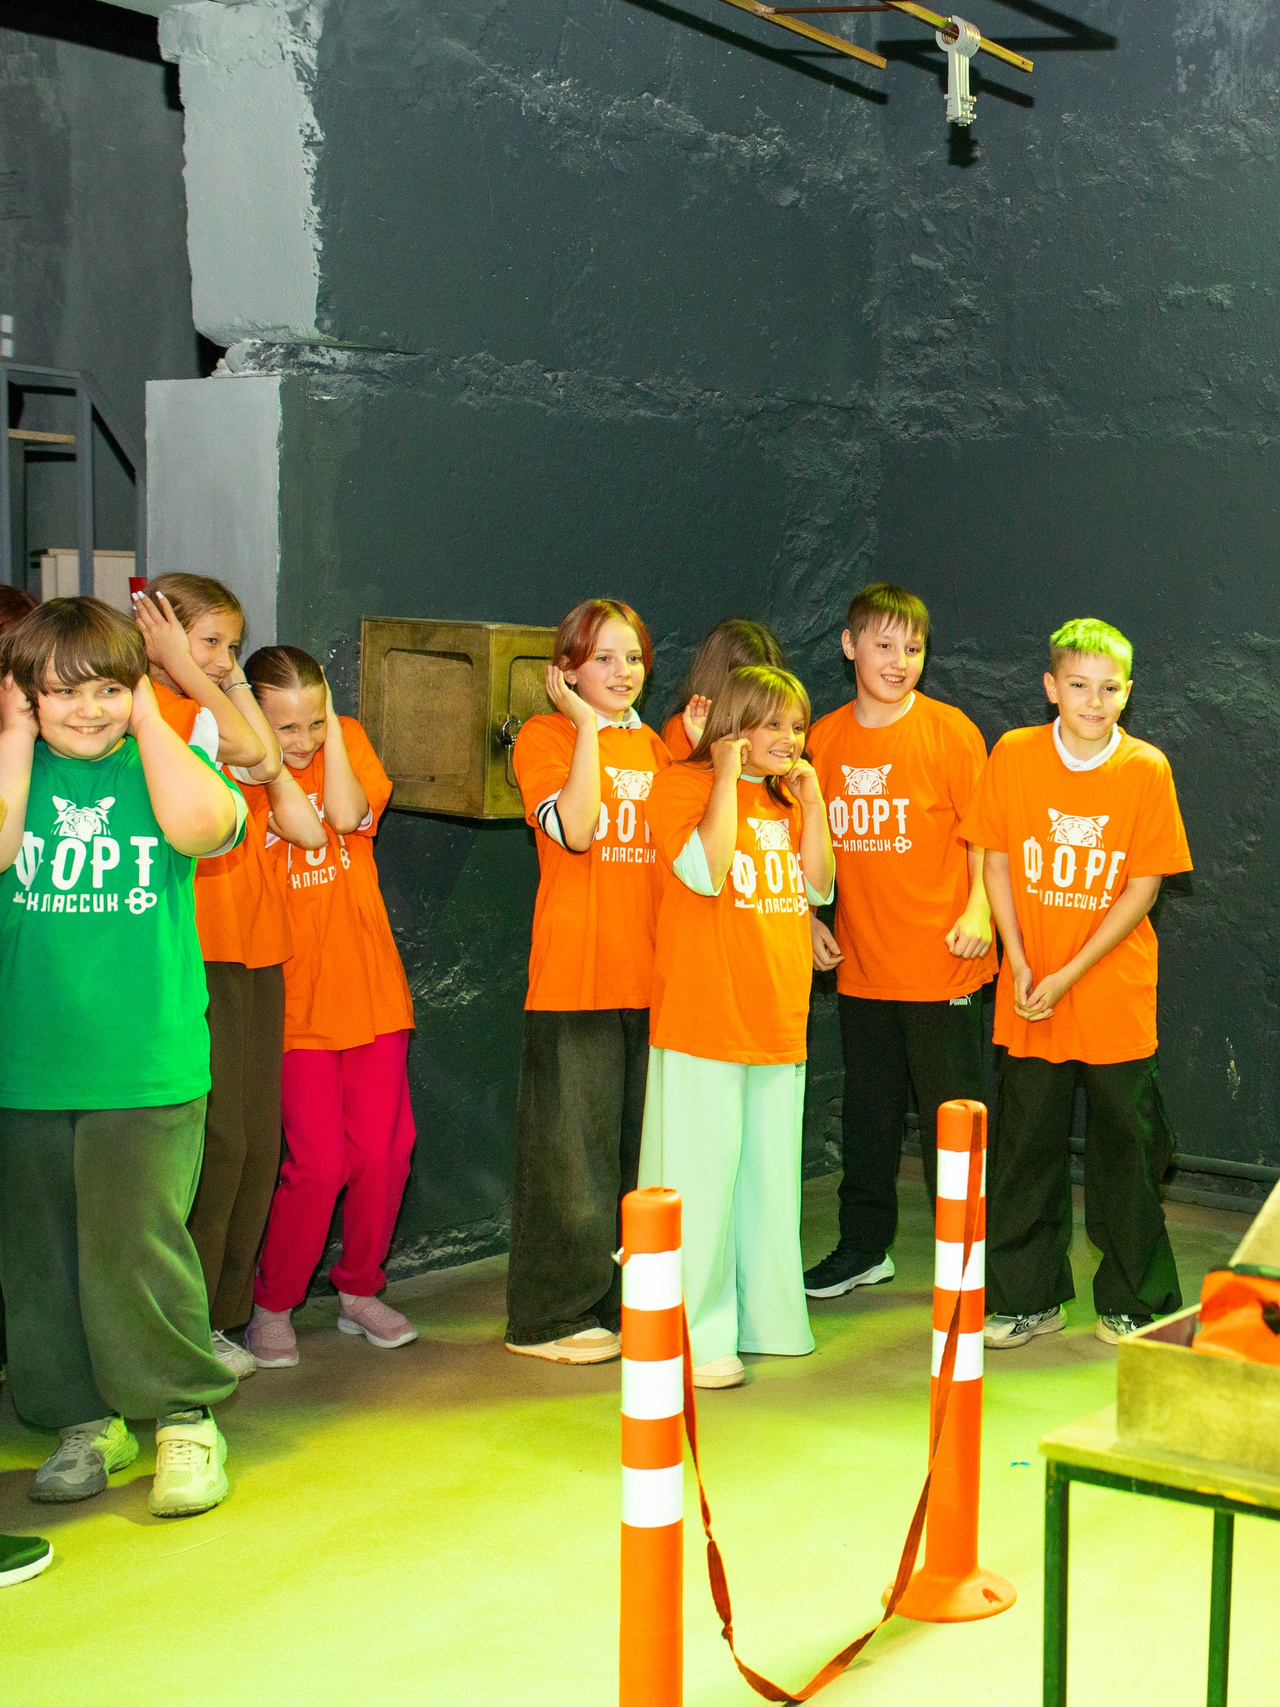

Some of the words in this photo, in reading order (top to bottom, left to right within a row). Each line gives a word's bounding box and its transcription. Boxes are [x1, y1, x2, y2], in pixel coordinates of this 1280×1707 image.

[829, 796, 910, 838] ФОРТ
[601, 846, 656, 864] КЛАССИК
[843, 839, 892, 851] КЛАССИК
[13, 831, 158, 891] ФОРТ
[26, 891, 118, 913] КЛАССИК
[756, 897, 798, 914] КЛАССИ
